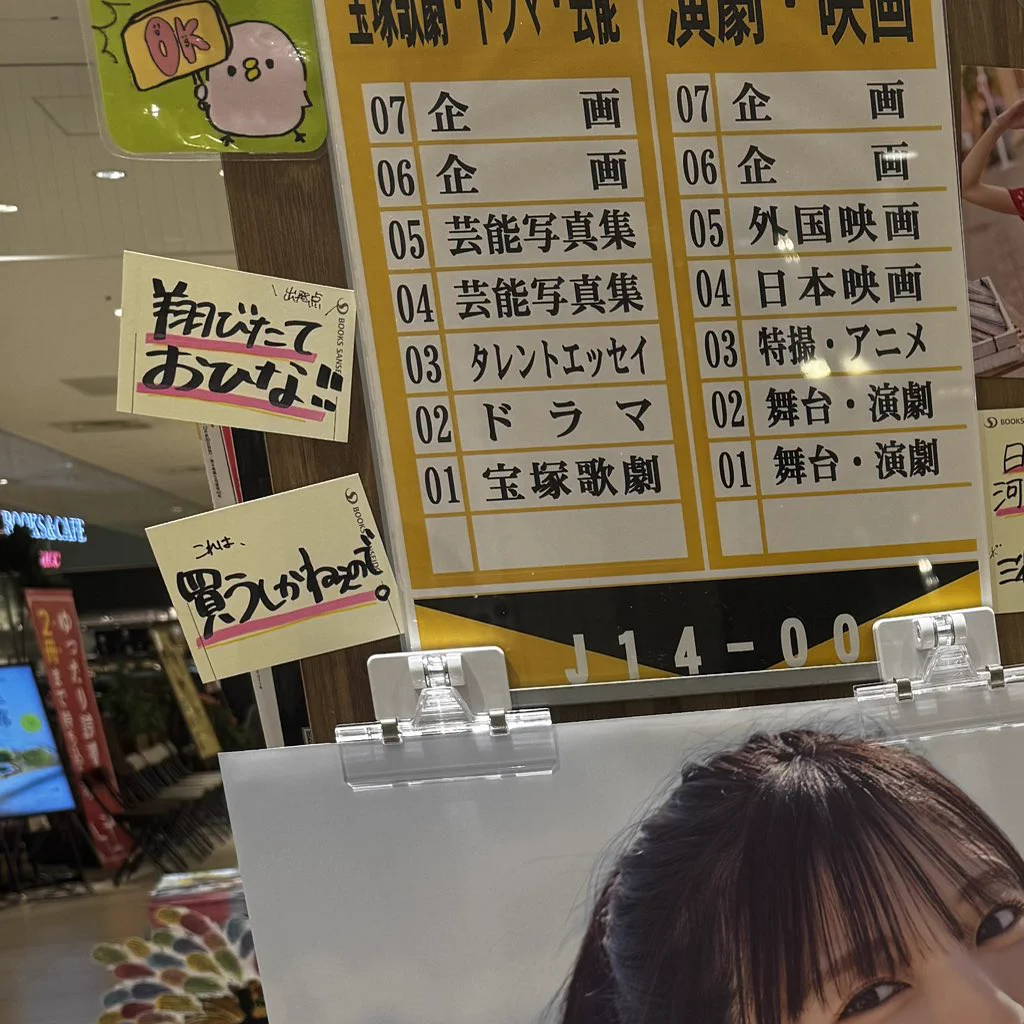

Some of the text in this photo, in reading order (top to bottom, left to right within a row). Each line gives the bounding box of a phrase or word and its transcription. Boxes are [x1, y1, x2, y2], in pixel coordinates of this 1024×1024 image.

[145, 17, 210, 77] OK
[371, 96, 406, 135] 07
[677, 85, 709, 123] 07
[377, 159, 415, 197] 06
[682, 148, 717, 186] 06
[388, 208, 637, 260] 05 芸能写真集
[689, 201, 920, 248] 05 外国映画
[396, 272, 645, 324] 04 芸能写真集
[696, 263, 922, 308] 04 日本映画
[152, 277, 323, 355] 翔びたて
[336, 318, 346, 347] BOOKS
[405, 335, 647, 384] 03 タレントエッセイ
[704, 322, 927, 369] 03 特撮・アニメ
[415, 404, 452, 445] 02
[711, 380, 935, 429] 02 舞台・演劇
[1000, 417, 1024, 425] BOOKS
[424, 455, 662, 505] 01 宝塚歌劇
[718, 438, 940, 489] 01 舞台・演劇
[352, 506, 368, 534] BOOKS
